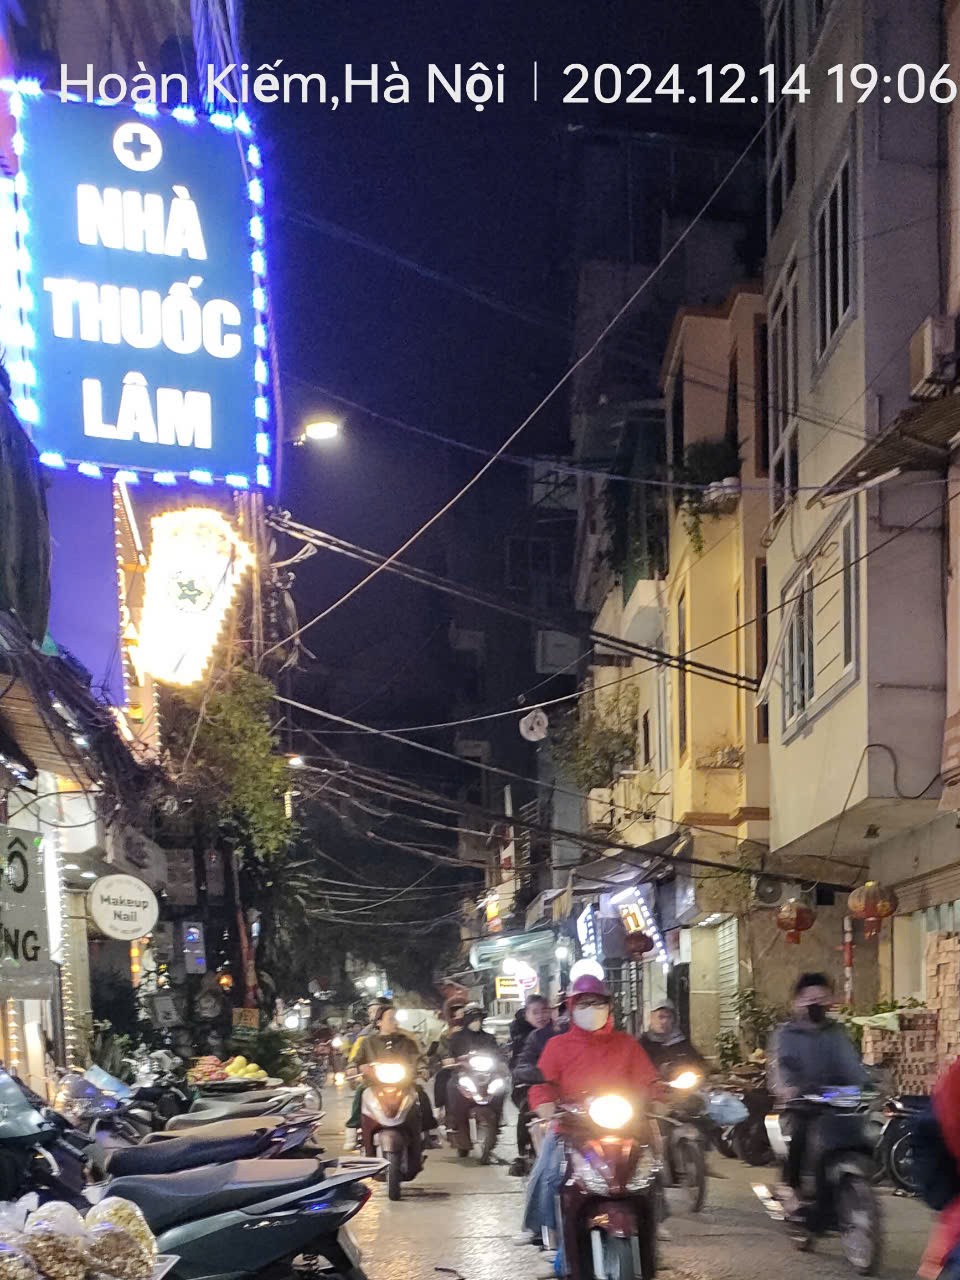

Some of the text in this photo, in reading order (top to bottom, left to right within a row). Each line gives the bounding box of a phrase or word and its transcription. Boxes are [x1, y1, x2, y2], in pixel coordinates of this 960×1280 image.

[77, 184, 207, 260] NHÀ
[43, 276, 242, 358] THUỐC
[82, 371, 213, 449] LÂM
[100, 894, 150, 910] Makeup
[113, 910, 138, 922] Nail
